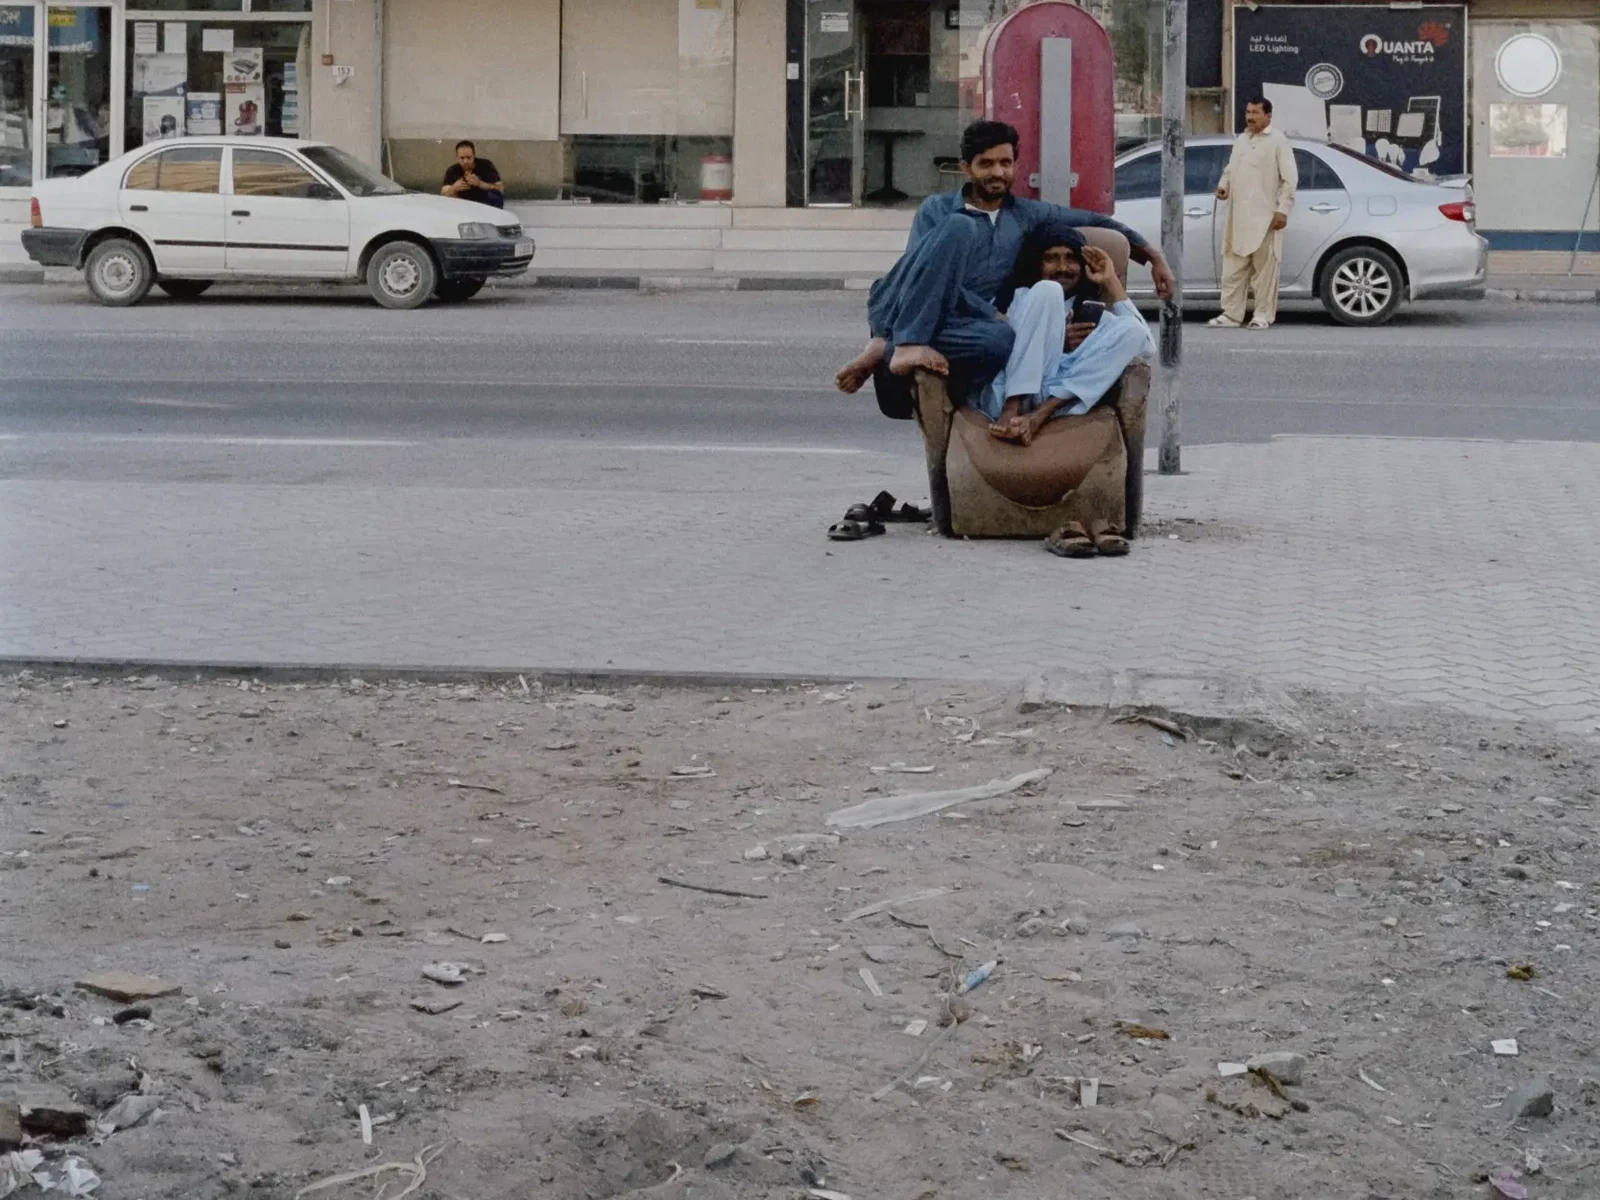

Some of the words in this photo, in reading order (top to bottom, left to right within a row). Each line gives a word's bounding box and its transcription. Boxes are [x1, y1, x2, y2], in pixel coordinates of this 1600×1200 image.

[1249, 44, 1265, 52] LED
[1267, 44, 1299, 54] Lighting
[1360, 34, 1434, 54] QUANTA
